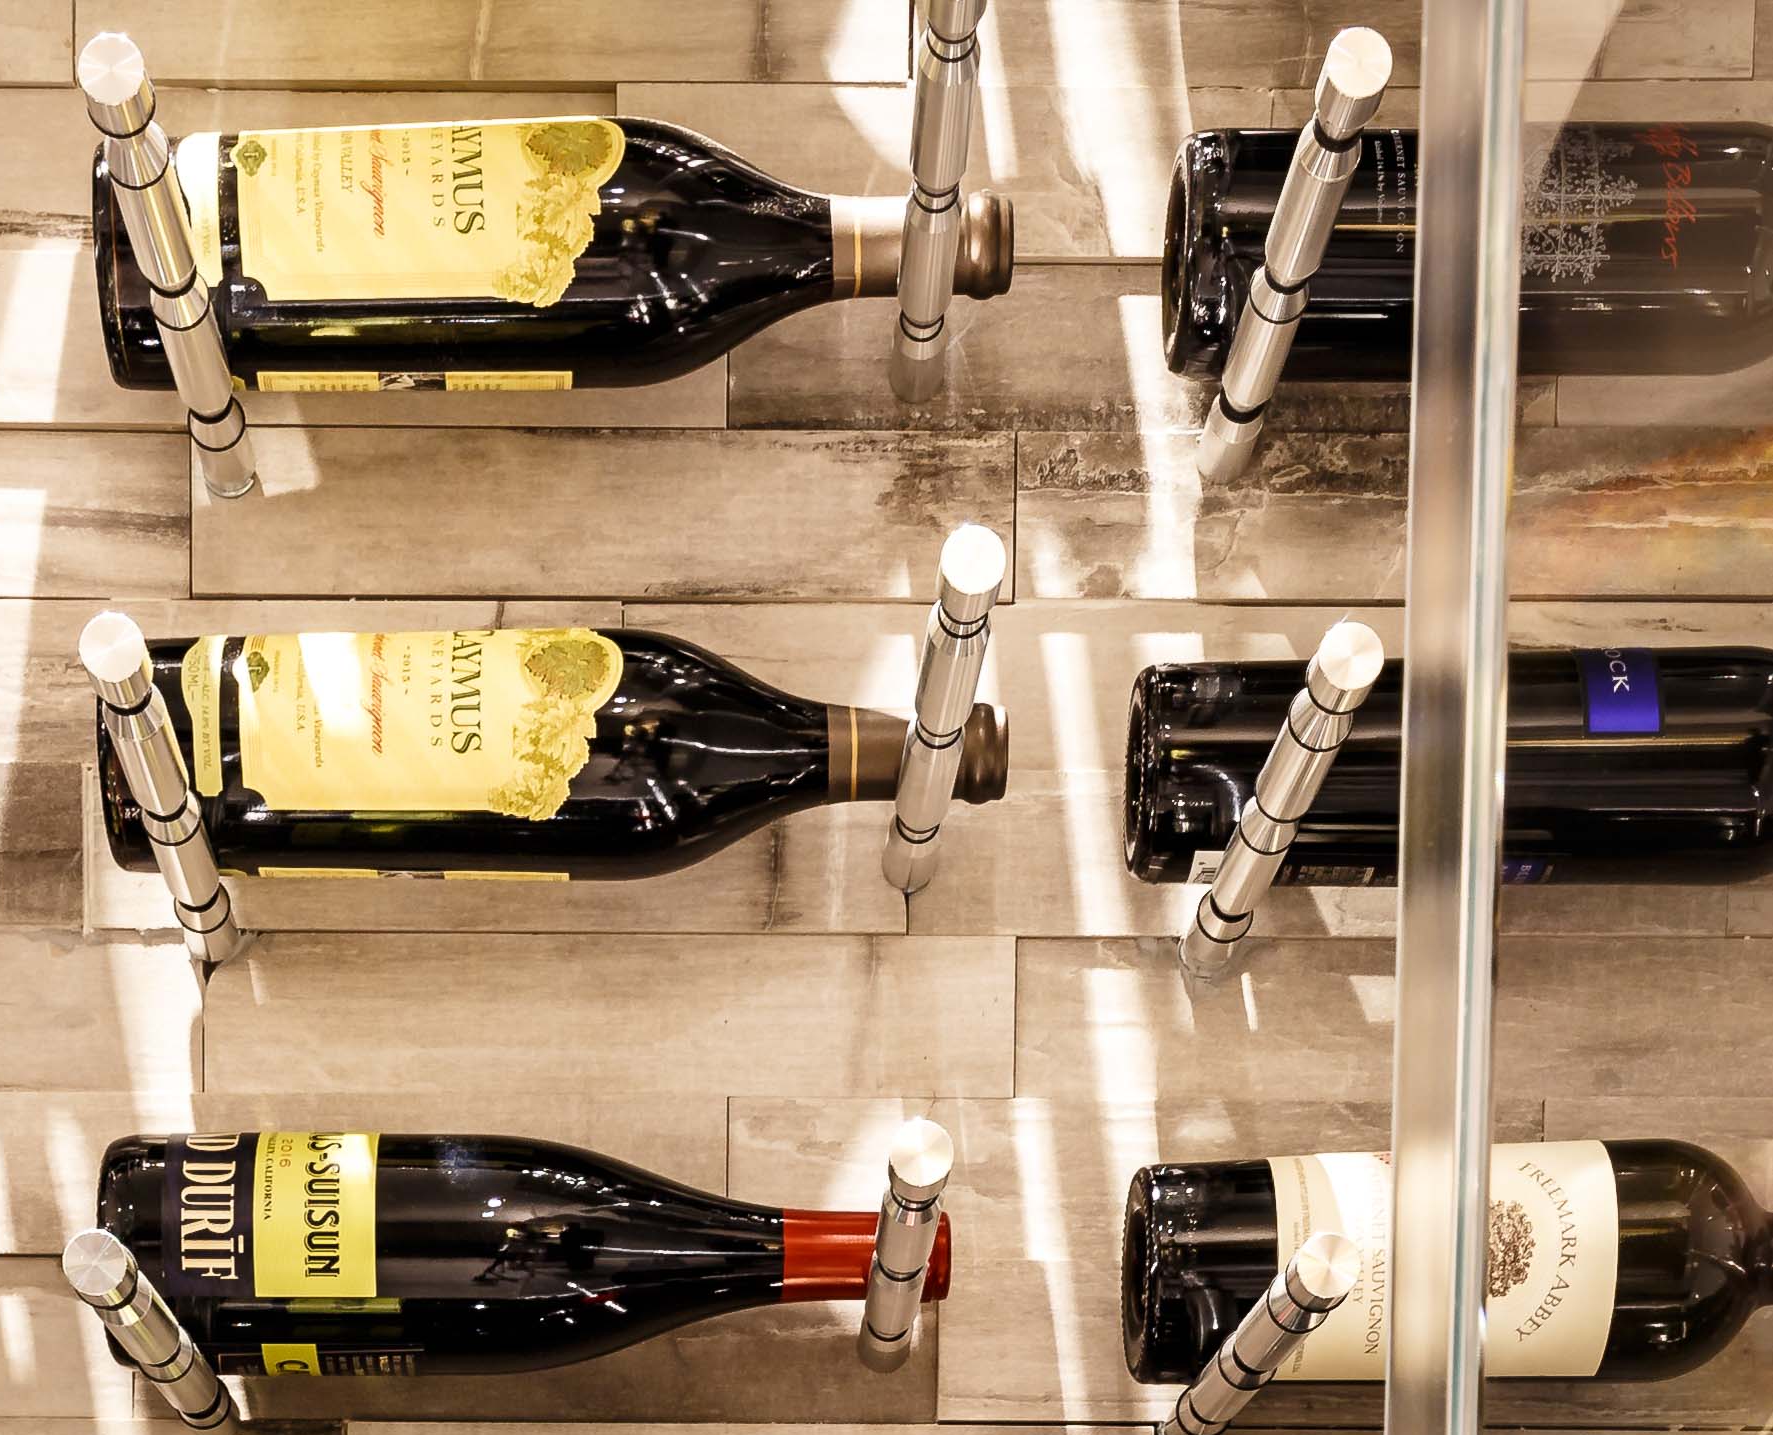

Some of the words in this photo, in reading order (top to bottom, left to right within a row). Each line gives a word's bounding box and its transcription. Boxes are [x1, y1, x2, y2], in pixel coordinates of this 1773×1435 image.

[452, 126, 485, 234] AYMUS
[1604, 649, 1630, 693] OCK
[279, 1138, 294, 1168] 2016
[263, 1158, 275, 1220] CALIFORNIA
[1518, 1161, 1577, 1269] FREEMARK
[1364, 1249, 1385, 1355] SAUVIGNON
[1514, 1274, 1570, 1344] ABBEY
